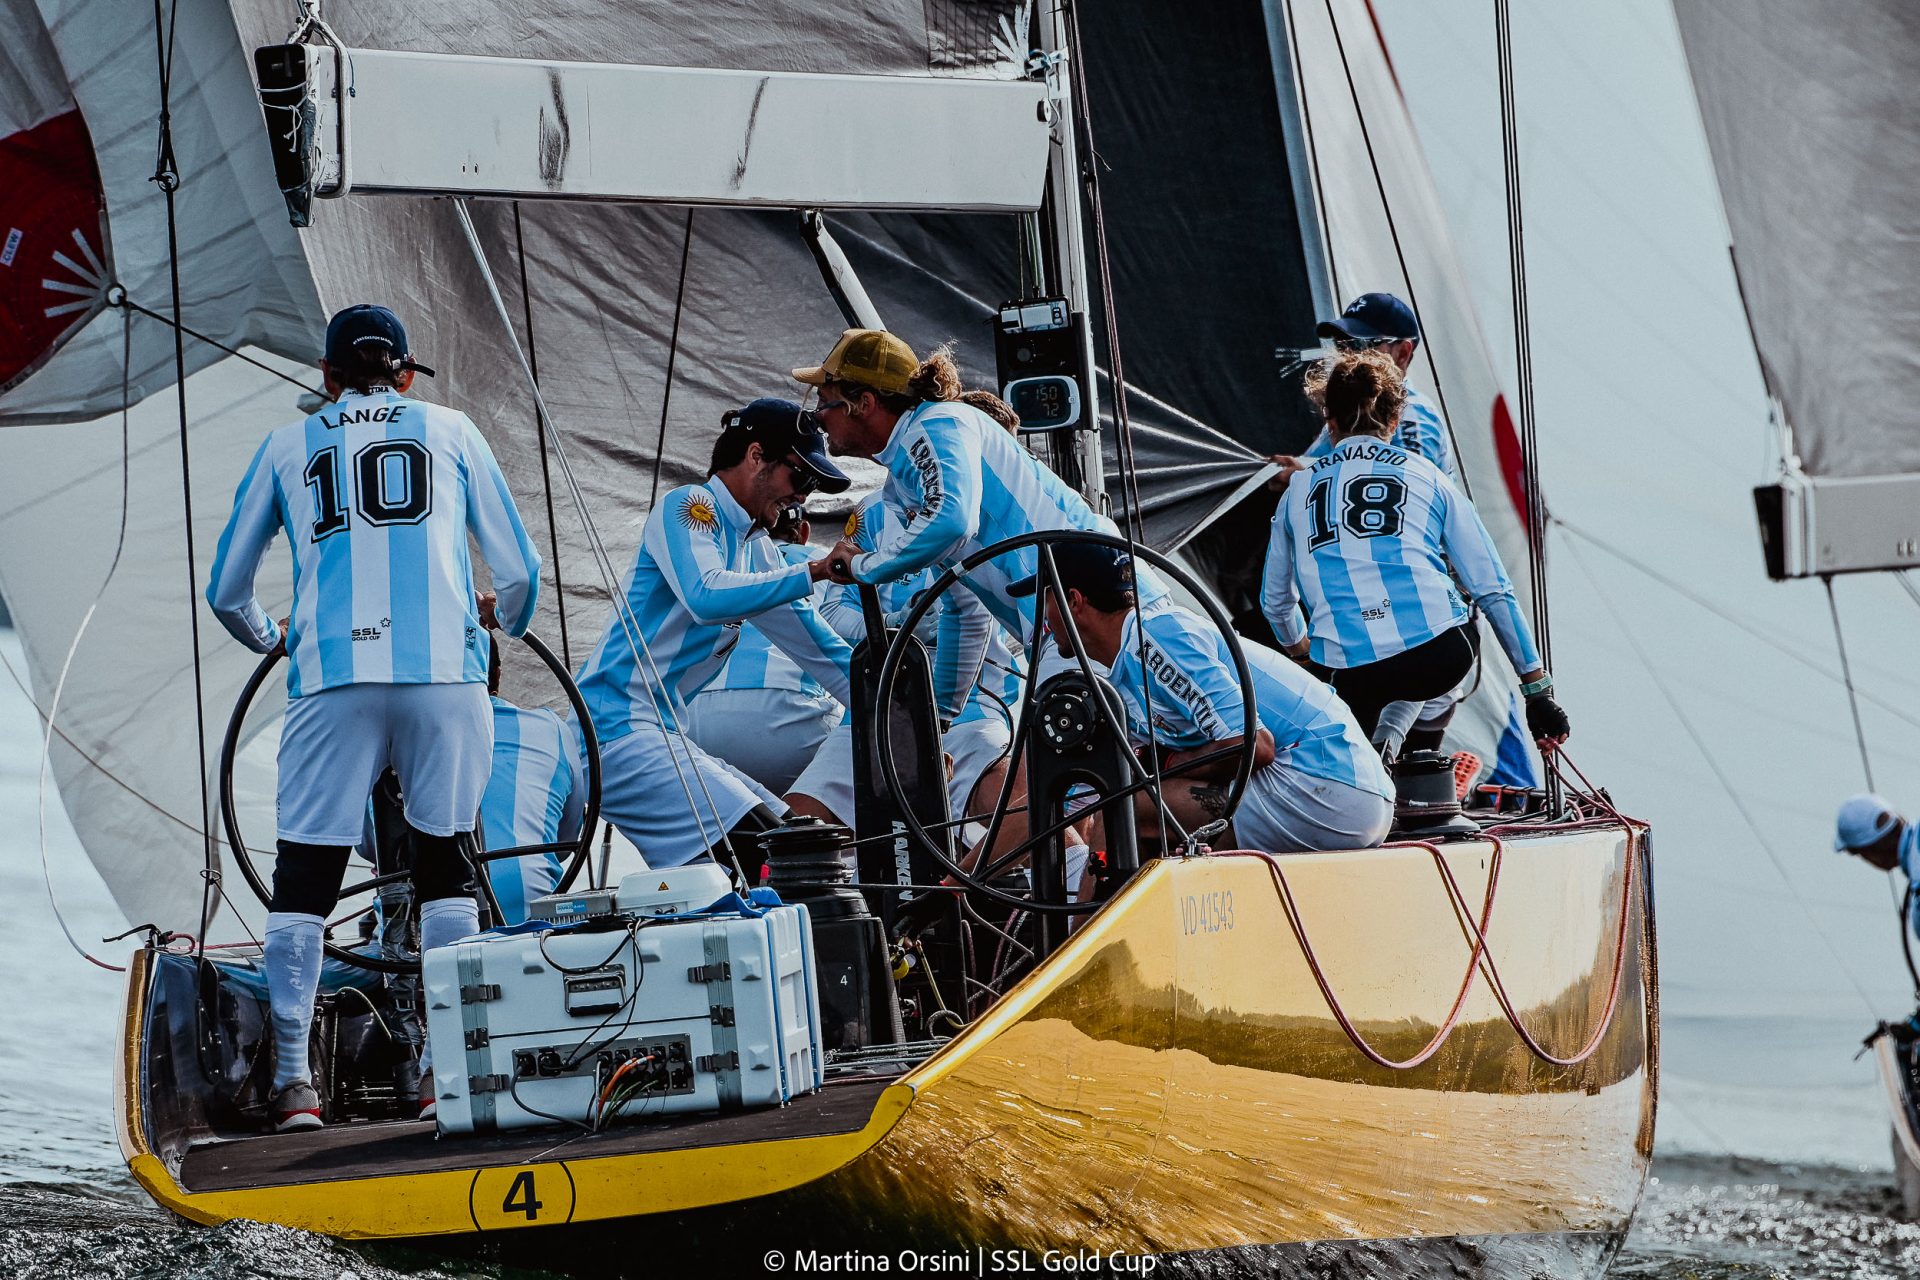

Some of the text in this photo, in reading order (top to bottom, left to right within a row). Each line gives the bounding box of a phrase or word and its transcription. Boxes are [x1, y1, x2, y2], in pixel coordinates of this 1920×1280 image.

[319, 405, 407, 430] LANGE
[1042, 402, 1060, 417] 72
[1306, 444, 1408, 474] TRAVASCIO
[303, 438, 433, 544] 10
[1305, 473, 1409, 554] 18
[1361, 608, 1385, 618] SSL
[351, 627, 382, 637] SSL
[891, 820, 913, 901] HARKEN
[1180, 889, 1234, 935] VD 41543
[840, 974, 848, 986] 4
[502, 1170, 543, 1221] 4
